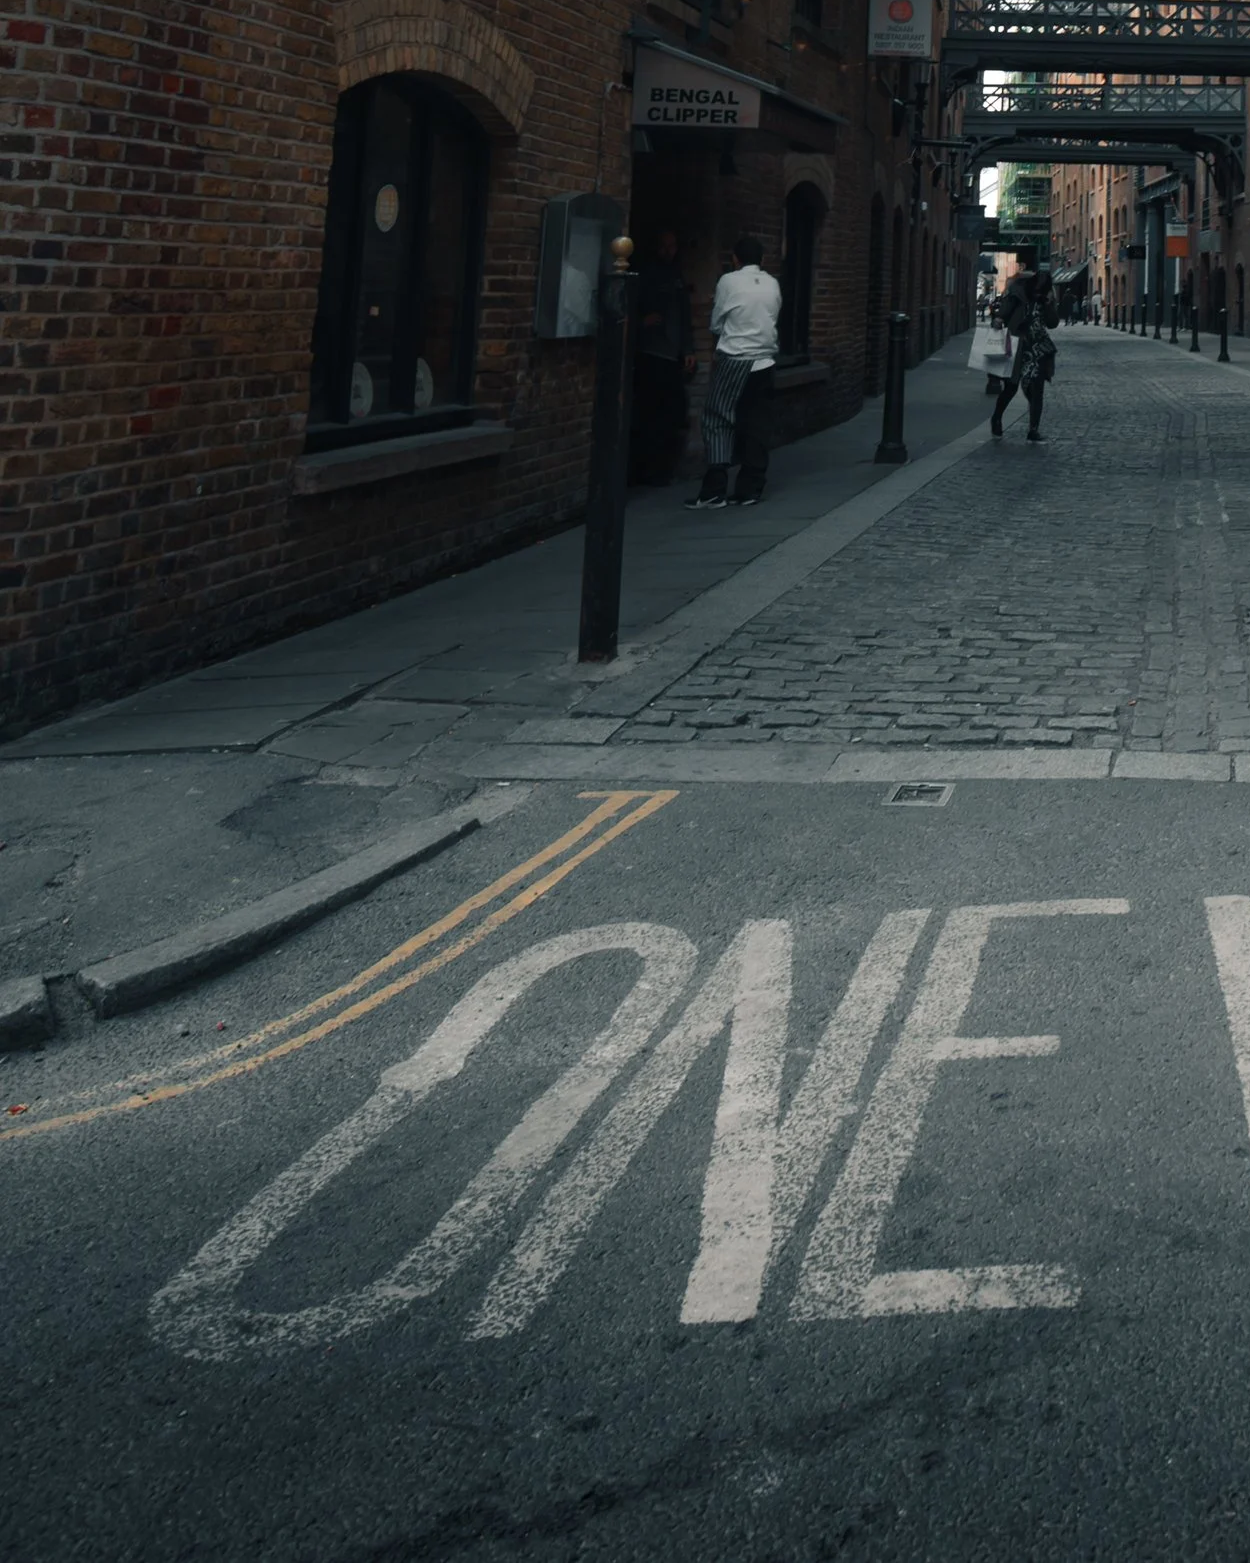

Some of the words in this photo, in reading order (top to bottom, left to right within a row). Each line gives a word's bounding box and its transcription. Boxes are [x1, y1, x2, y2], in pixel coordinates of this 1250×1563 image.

[874, 32, 925, 40] RESTAURANT
[650, 87, 740, 106] BENGAL
[647, 107, 738, 124] CLIPPER
[147, 898, 1132, 1364] ONE
